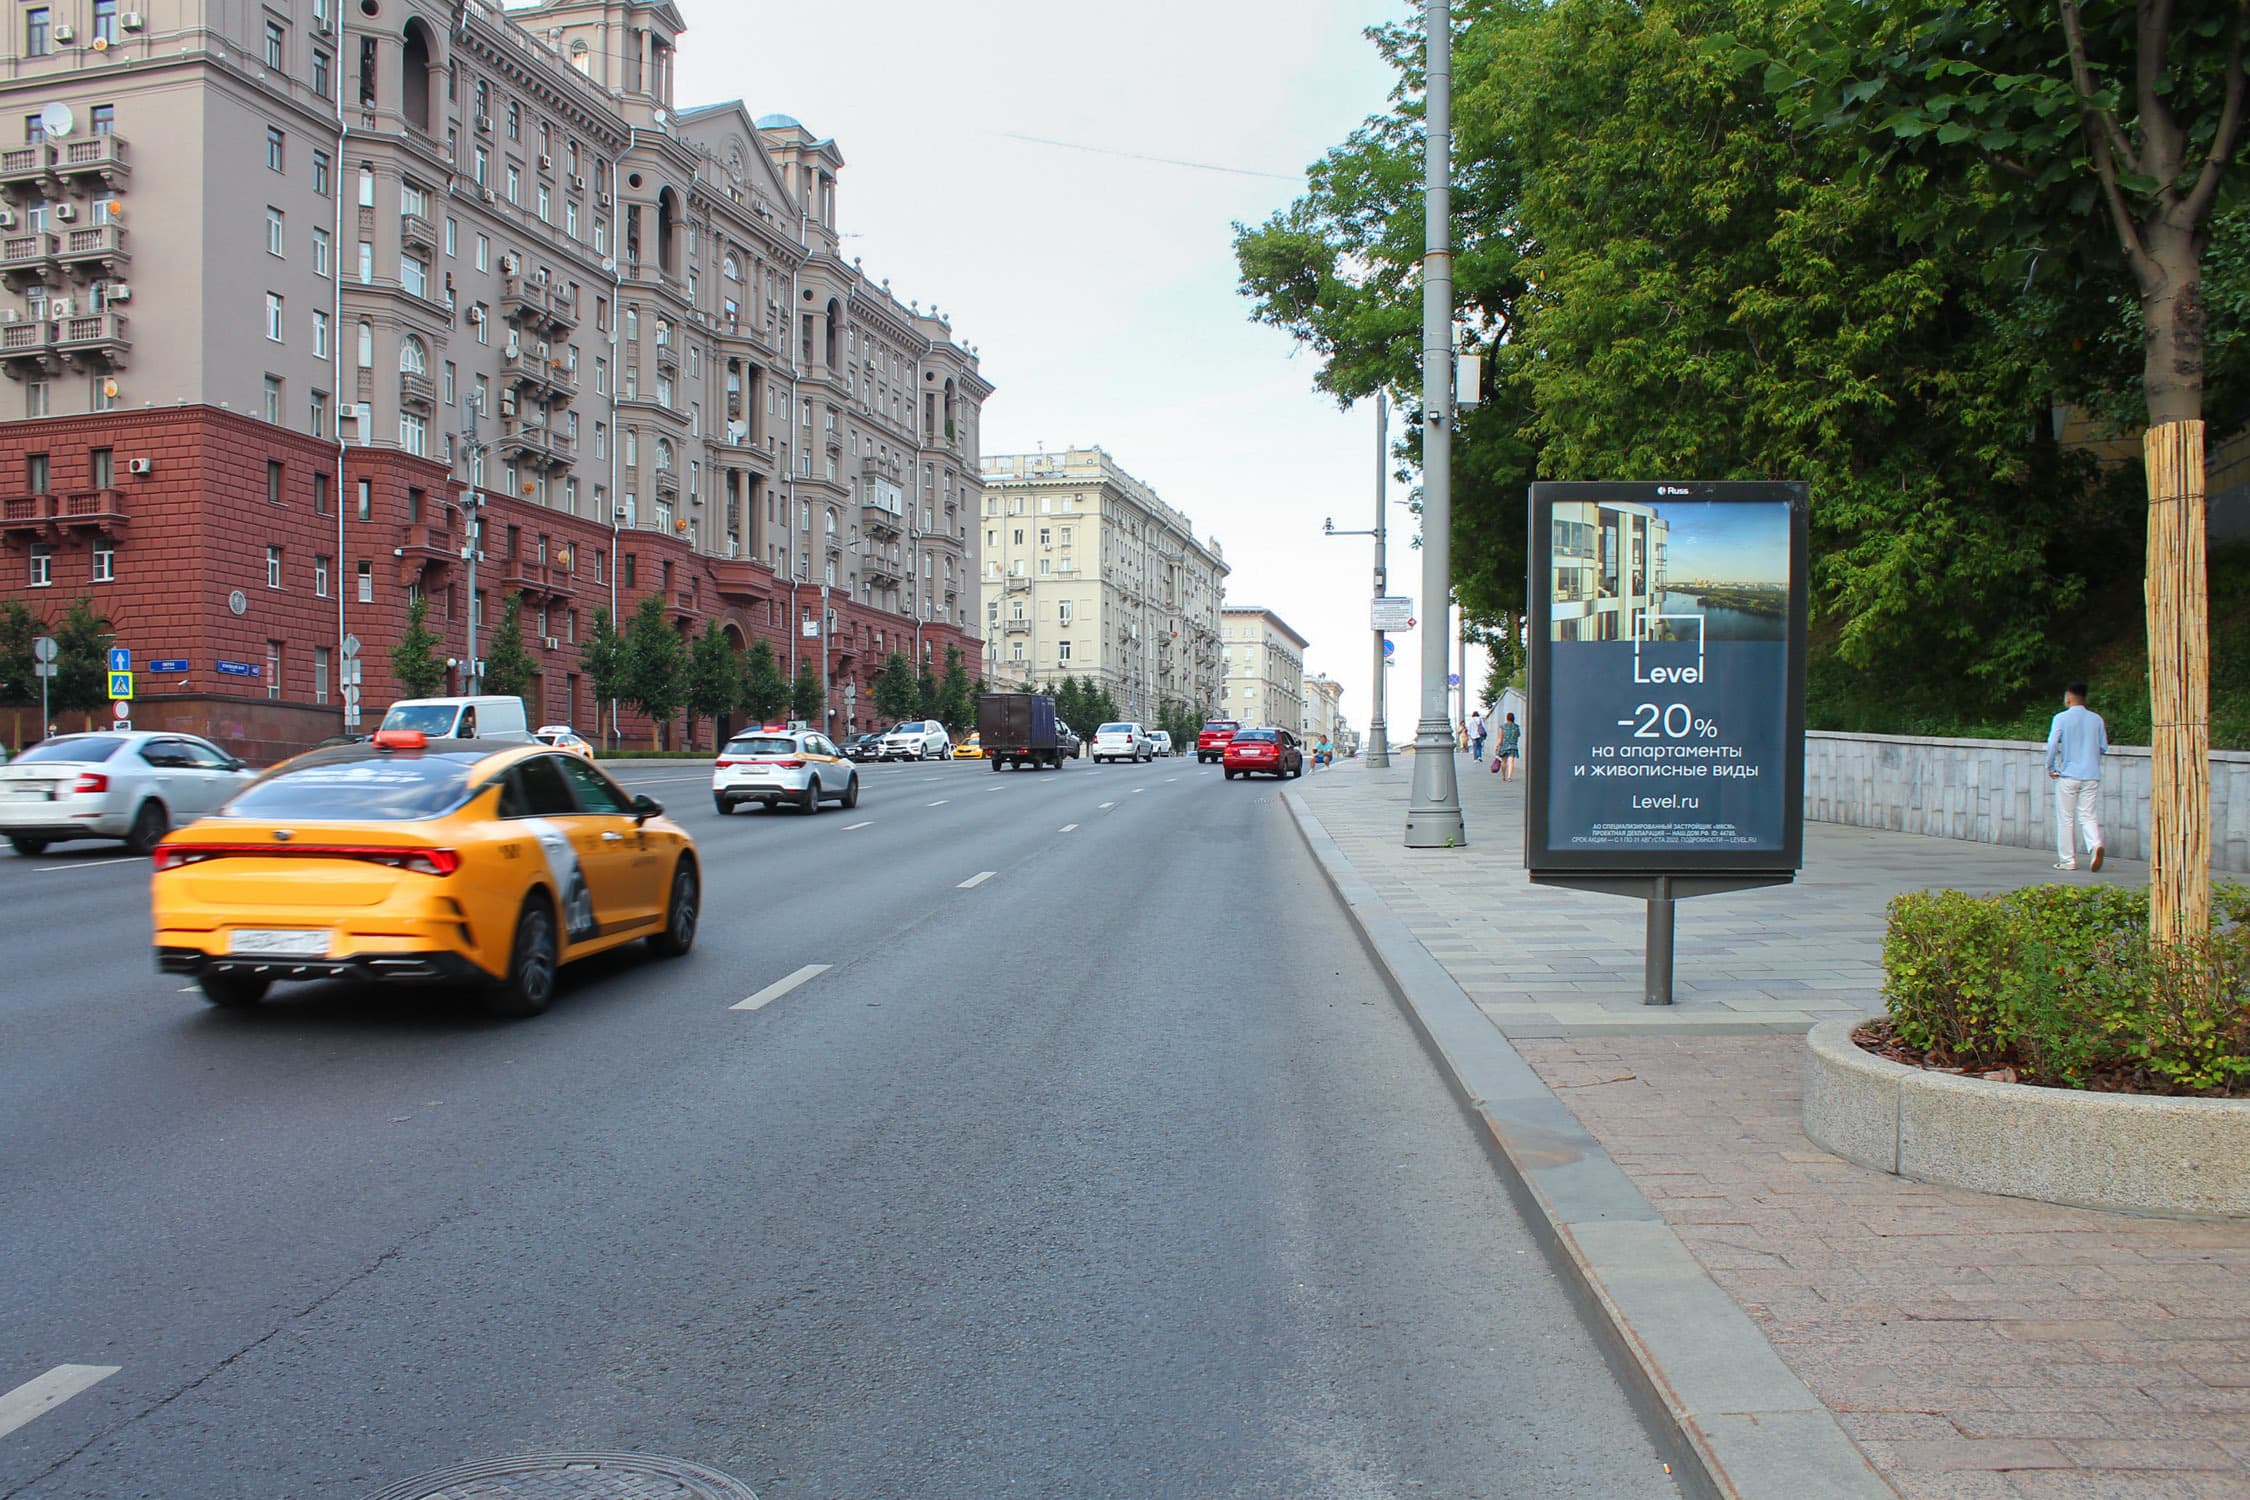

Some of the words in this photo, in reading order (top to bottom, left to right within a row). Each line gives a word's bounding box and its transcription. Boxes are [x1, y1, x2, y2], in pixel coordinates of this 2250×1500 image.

[1667, 486, 1689, 495] Russ
[1634, 655, 1704, 683] Level
[1617, 703, 1718, 738] -20%
[1591, 745, 1614, 758] на
[1619, 745, 1742, 761] апартаменты
[1574, 765, 1585, 776] и
[1591, 765, 1707, 776] живописные
[1712, 765, 1759, 779] виды
[1632, 794, 1699, 809] Level.ru
